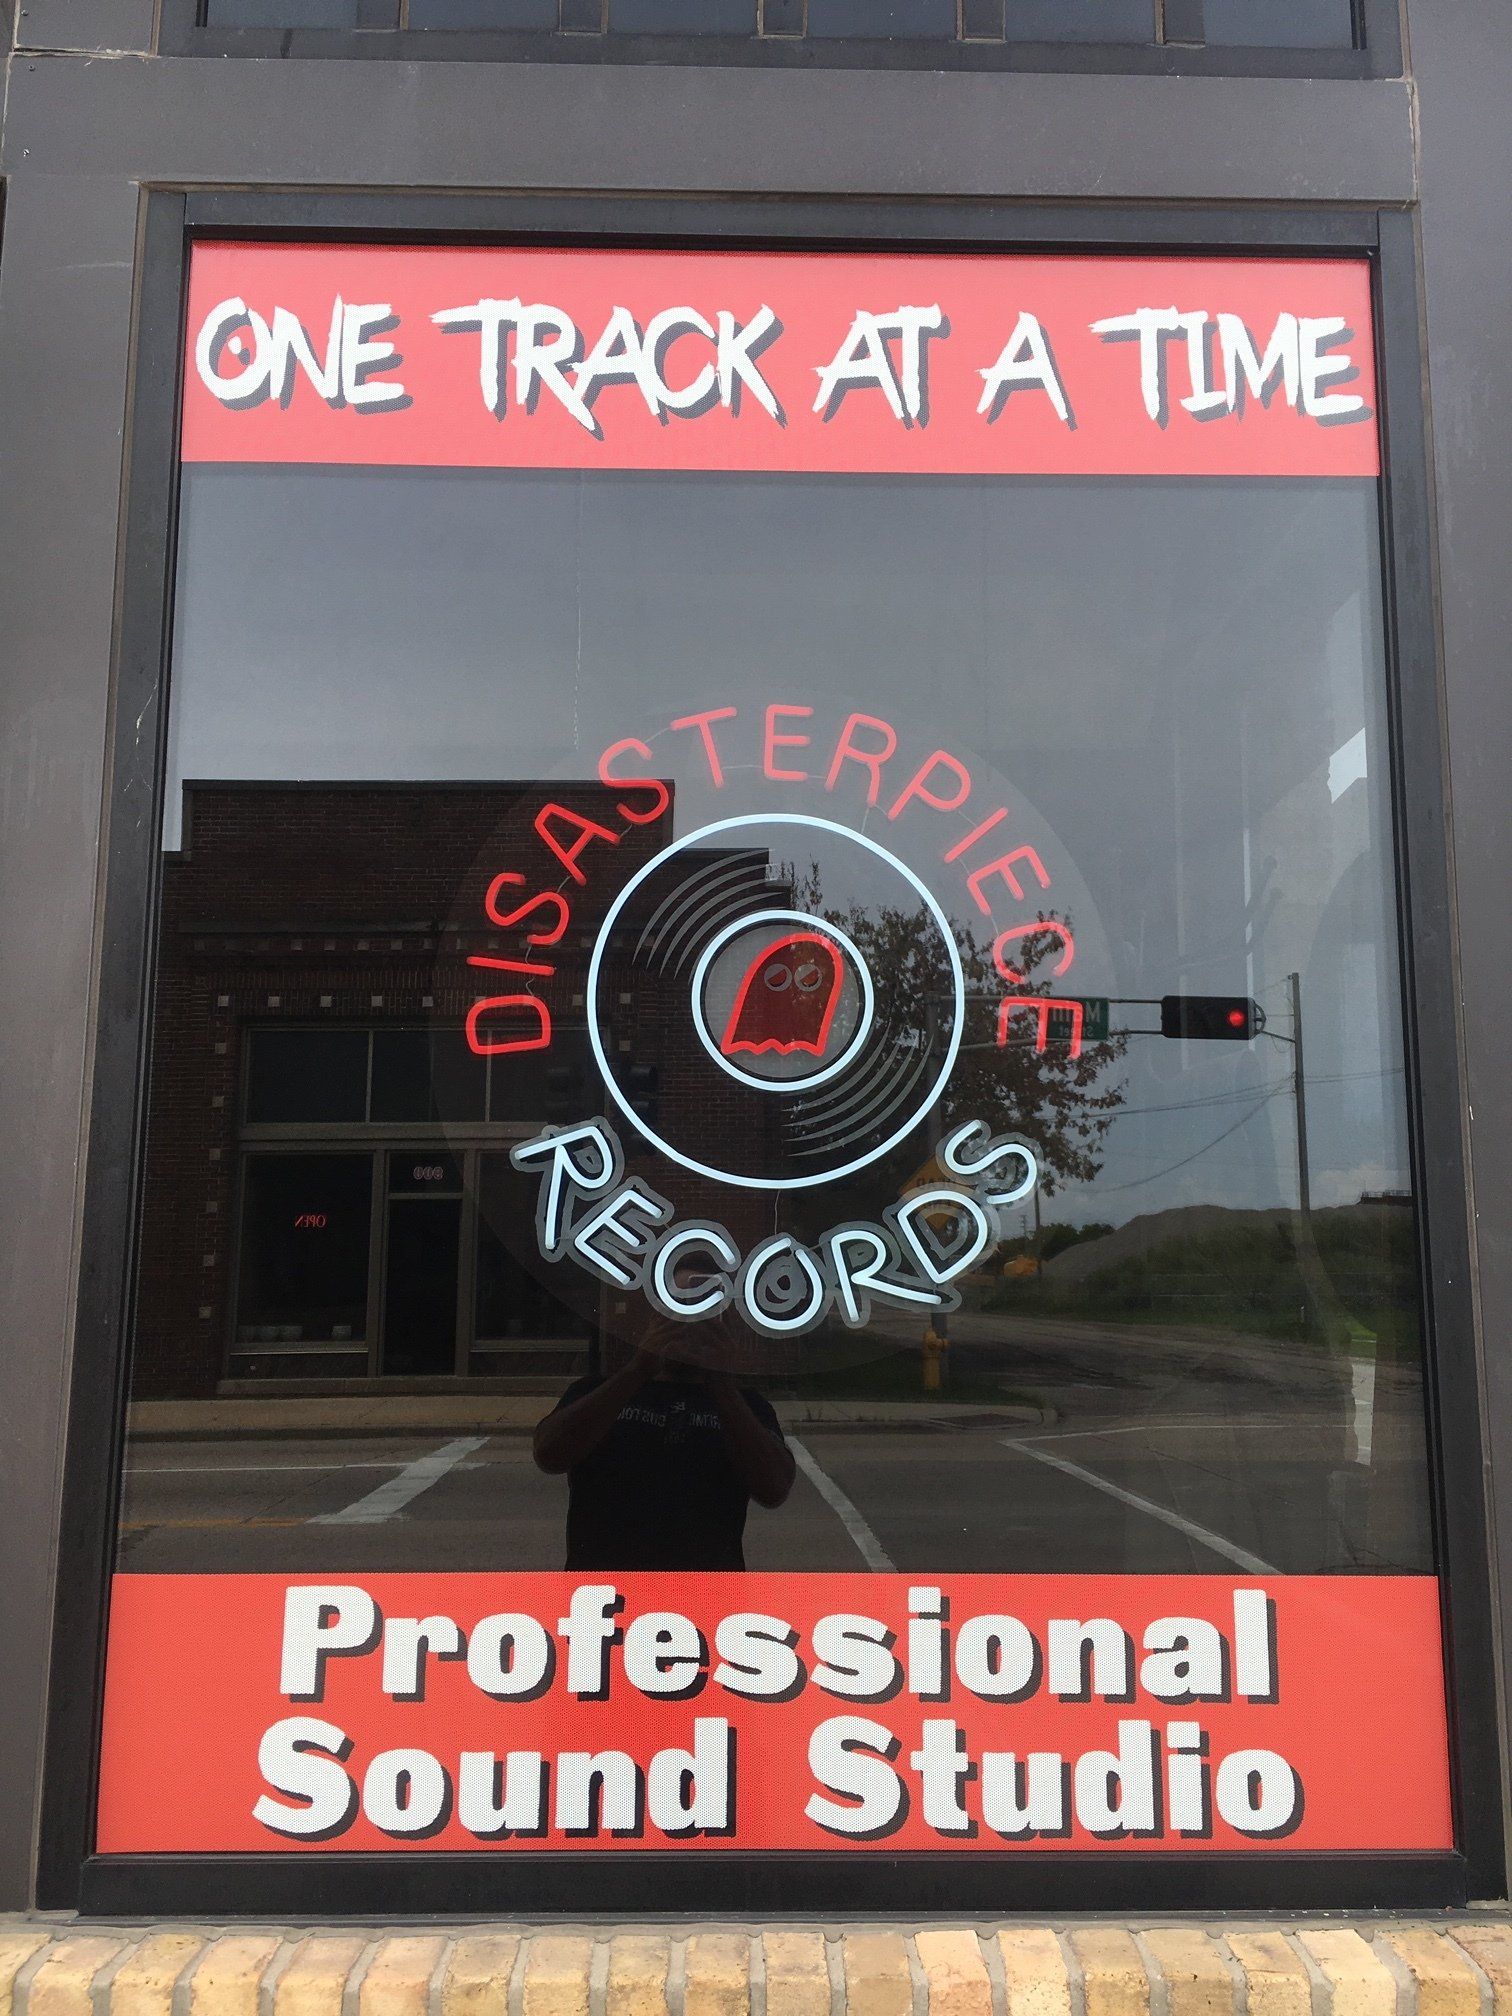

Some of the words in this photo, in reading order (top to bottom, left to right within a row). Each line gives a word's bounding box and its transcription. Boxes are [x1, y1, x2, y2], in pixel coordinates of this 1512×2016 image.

[195, 294, 412, 415] ONE
[430, 296, 787, 441] TRACK
[811, 303, 950, 430] AT
[975, 311, 1077, 430] A
[1087, 305, 1373, 427] TIME
[466, 704, 1084, 1059] DISASTERPIECE
[513, 1117, 1040, 1332] RECORDS
[280, 1584, 1279, 1703] Professional
[252, 1716, 738, 1838] Sound
[804, 1715, 1305, 1839] Studio
